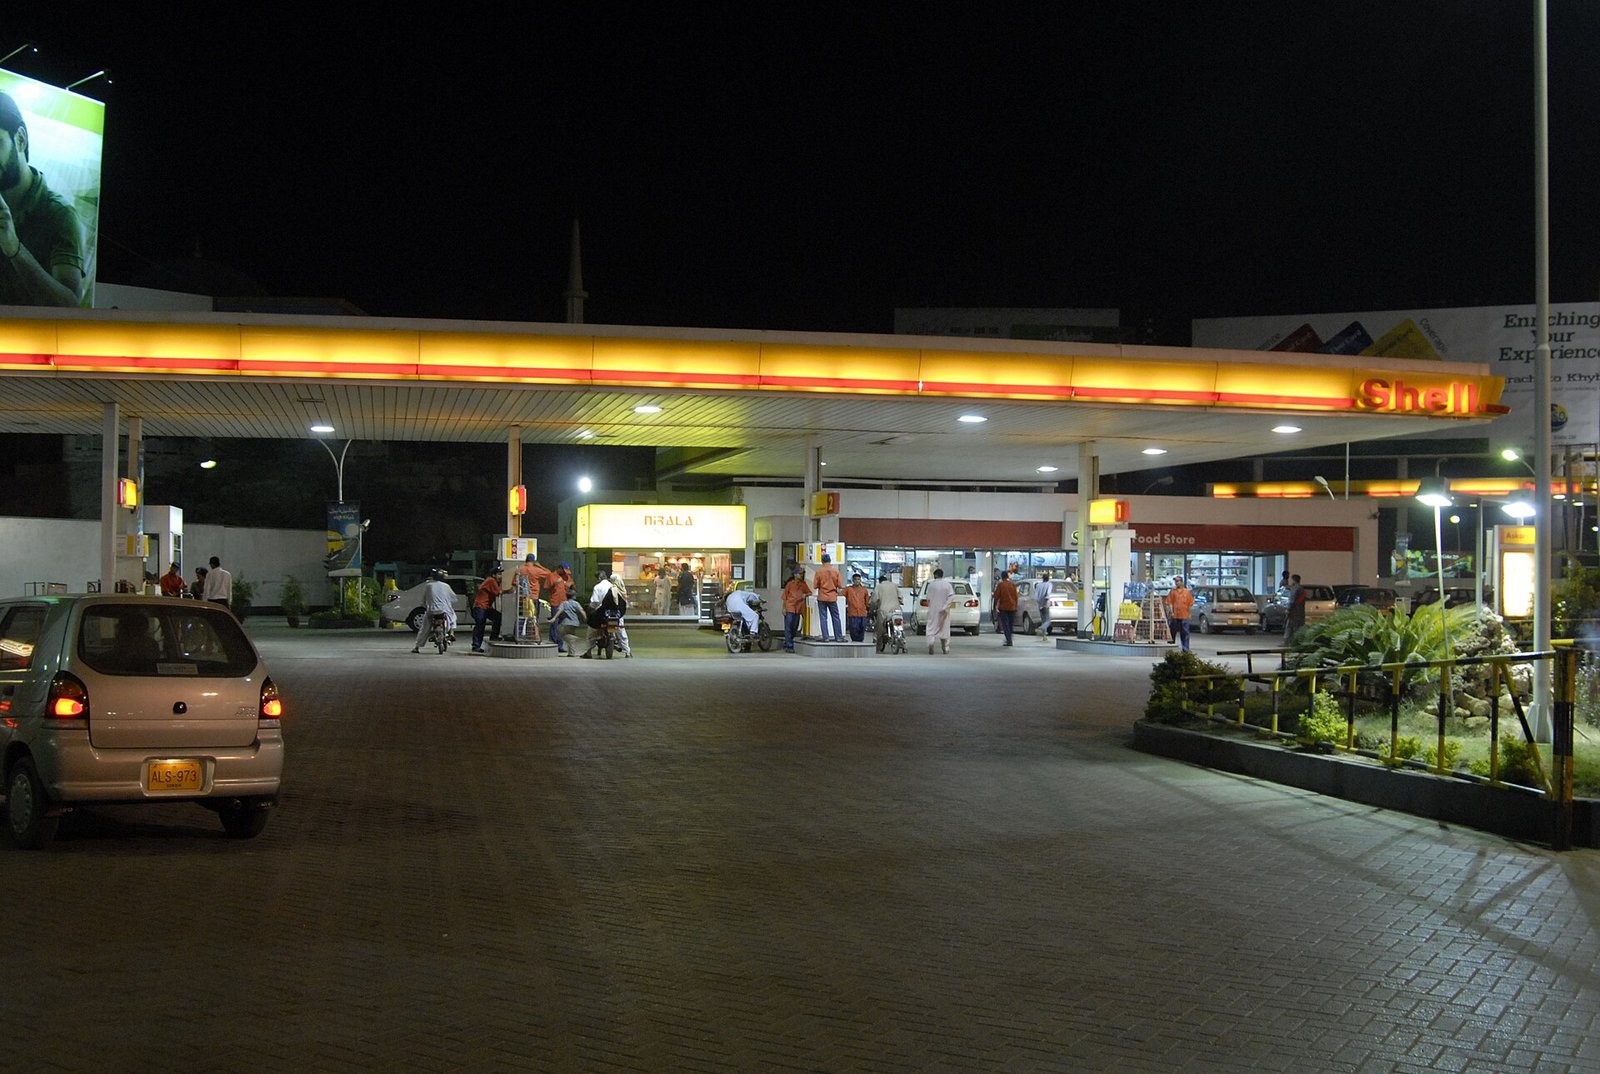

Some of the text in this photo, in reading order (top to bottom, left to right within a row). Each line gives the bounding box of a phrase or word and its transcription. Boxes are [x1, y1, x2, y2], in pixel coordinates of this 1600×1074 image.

[1503, 311, 1600, 329] Enrching
[1499, 345, 1600, 364] Exprienc
[1363, 378, 1478, 413] Shell
[828, 495, 833, 510] 2
[1117, 504, 1122, 518] 1
[1164, 533, 1196, 545] Store
[152, 770, 197, 783] ALS-973
